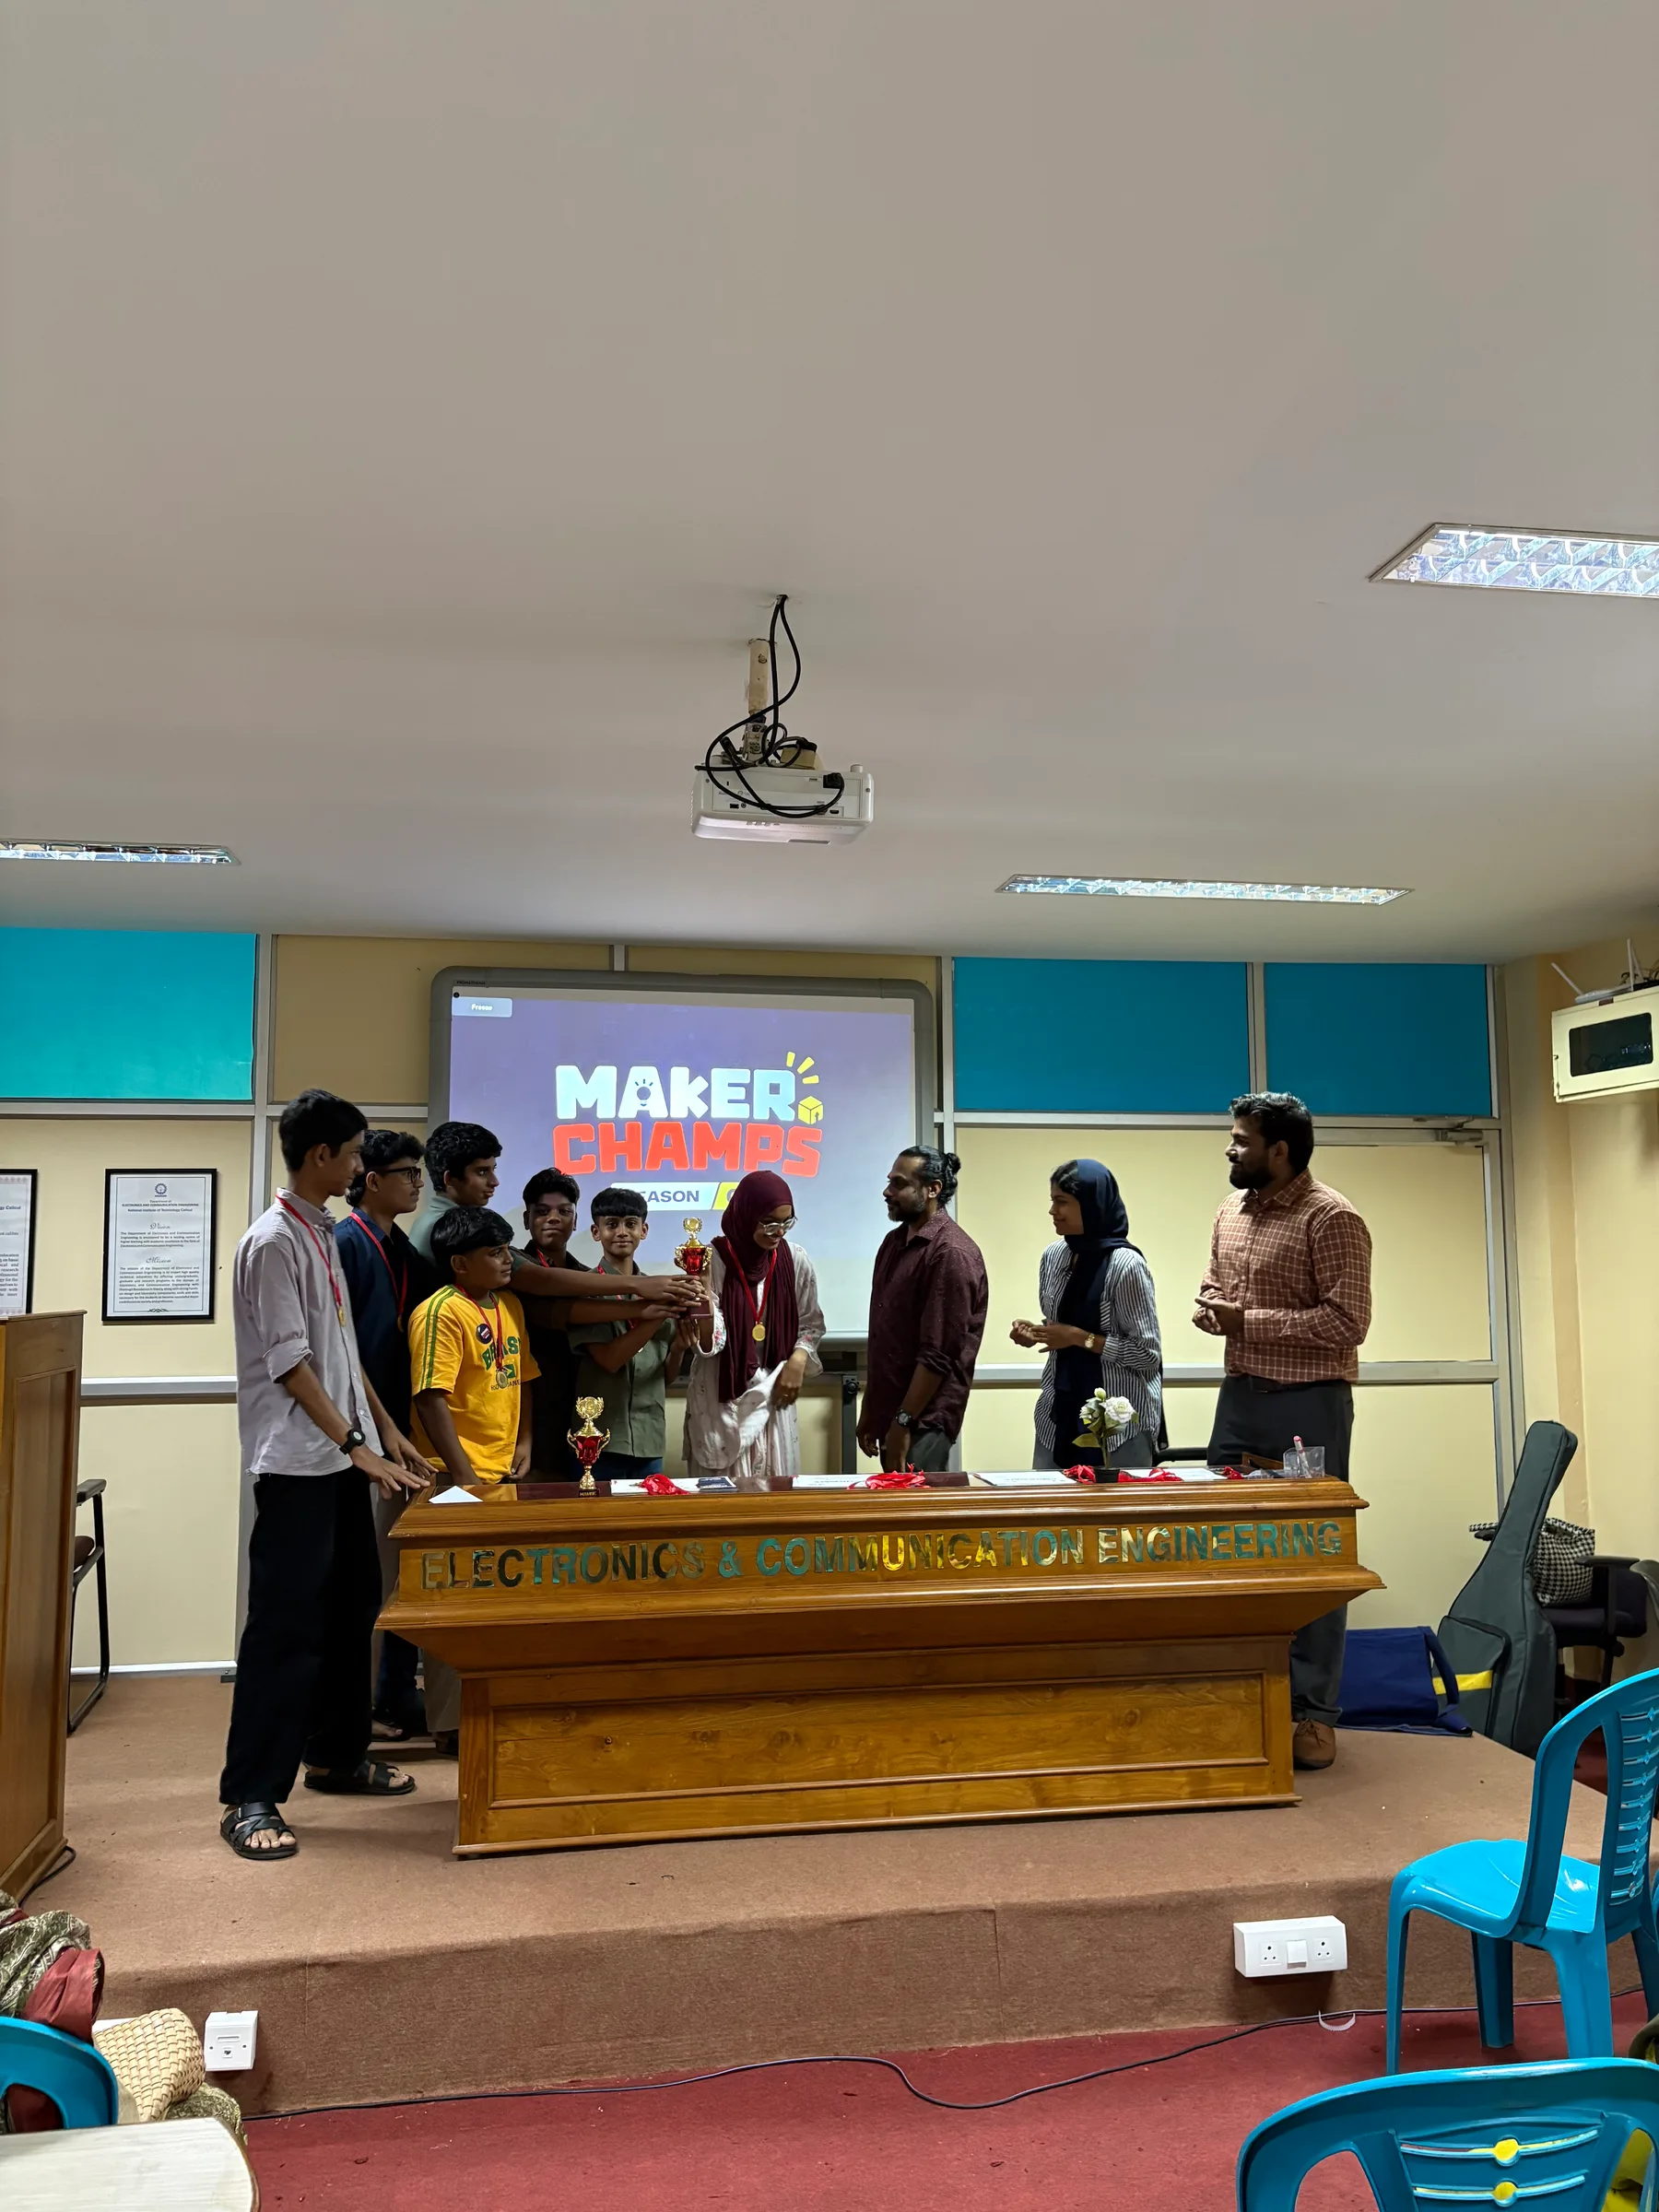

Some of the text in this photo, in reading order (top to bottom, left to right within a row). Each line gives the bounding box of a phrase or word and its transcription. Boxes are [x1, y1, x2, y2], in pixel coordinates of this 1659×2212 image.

[555, 1065, 795, 1122] MAKER
[553, 1122, 823, 1178] CHAMPS
[639, 1190, 700, 1203] ASON
[421, 1522, 1342, 1590] ELECTRONICS & COMMUNICATION ENGINEERING
